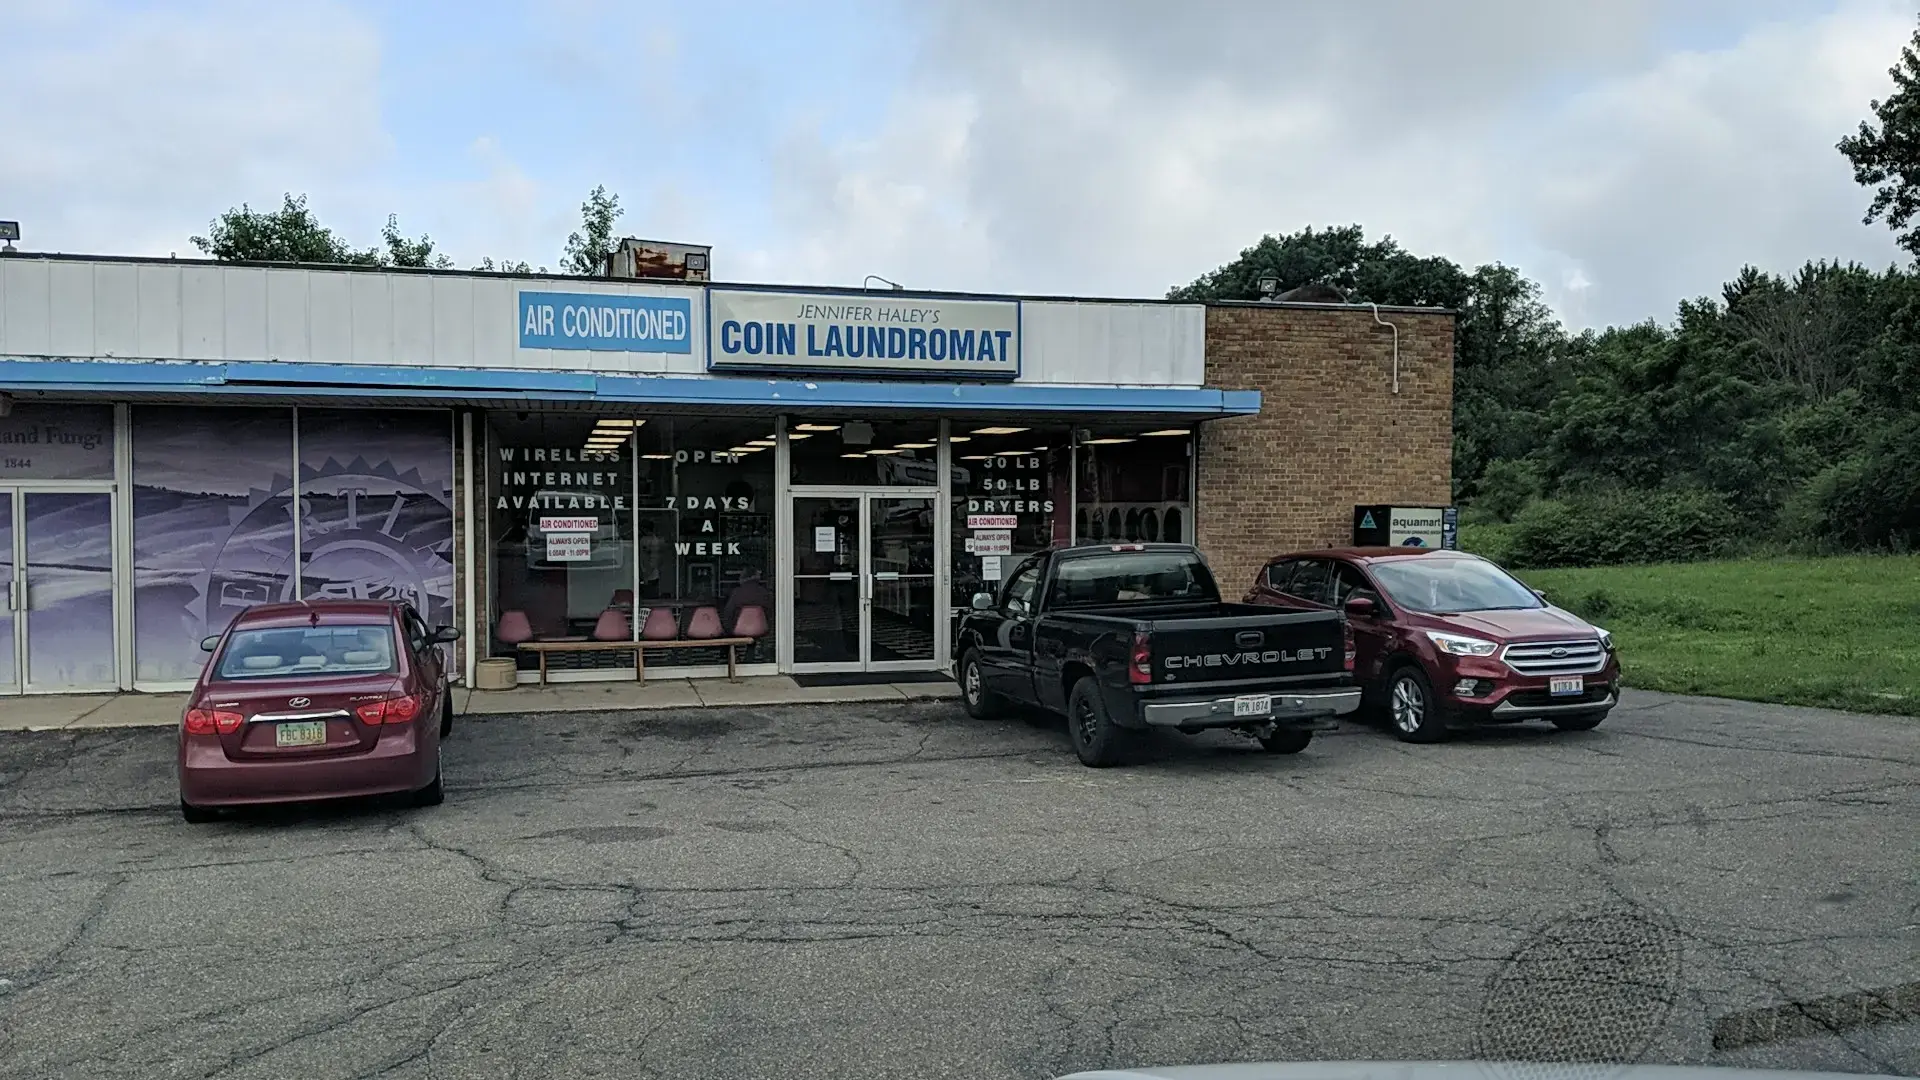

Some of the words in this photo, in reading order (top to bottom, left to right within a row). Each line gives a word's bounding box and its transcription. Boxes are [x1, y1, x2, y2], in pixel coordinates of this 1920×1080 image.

[797, 304, 872, 321] JENNIFER
[878, 308, 940, 323] HALEY'S
[525, 305, 555, 336] AIR
[562, 305, 686, 341] CONDITIONED
[721, 320, 796, 355] COIN
[807, 325, 1011, 362] LAUNDROMAT
[0, 428, 39, 444] and
[45, 426, 103, 450] Fungi
[499, 448, 620, 462] WIRELESS
[675, 449, 739, 464] OPEN
[5, 458, 31, 468] 1844
[983, 457, 1007, 469] 30
[1016, 457, 1040, 469] LB
[503, 472, 618, 485] INTERNET
[983, 479, 1007, 491] 50
[1015, 479, 1040, 491] LB
[497, 496, 624, 509] AVAILABLE
[665, 496, 676, 509] 7
[687, 496, 749, 510] DAYS
[968, 500, 1054, 513] DRYERS
[541, 519, 552, 529] AIR
[552, 519, 598, 529] CONDITIONED
[701, 519, 714, 533] A
[968, 517, 979, 526] AIR
[979, 517, 1017, 526] CONDITIONED
[1392, 518, 1441, 529] aquamart
[548, 537, 572, 545] ALWAYS
[572, 537, 589, 545] OPEN
[674, 542, 741, 556] WEEK
[1165, 647, 1333, 669] CHEVROLET
[1251, 700, 1268, 711] 1874
[280, 728, 298, 741] FBC
